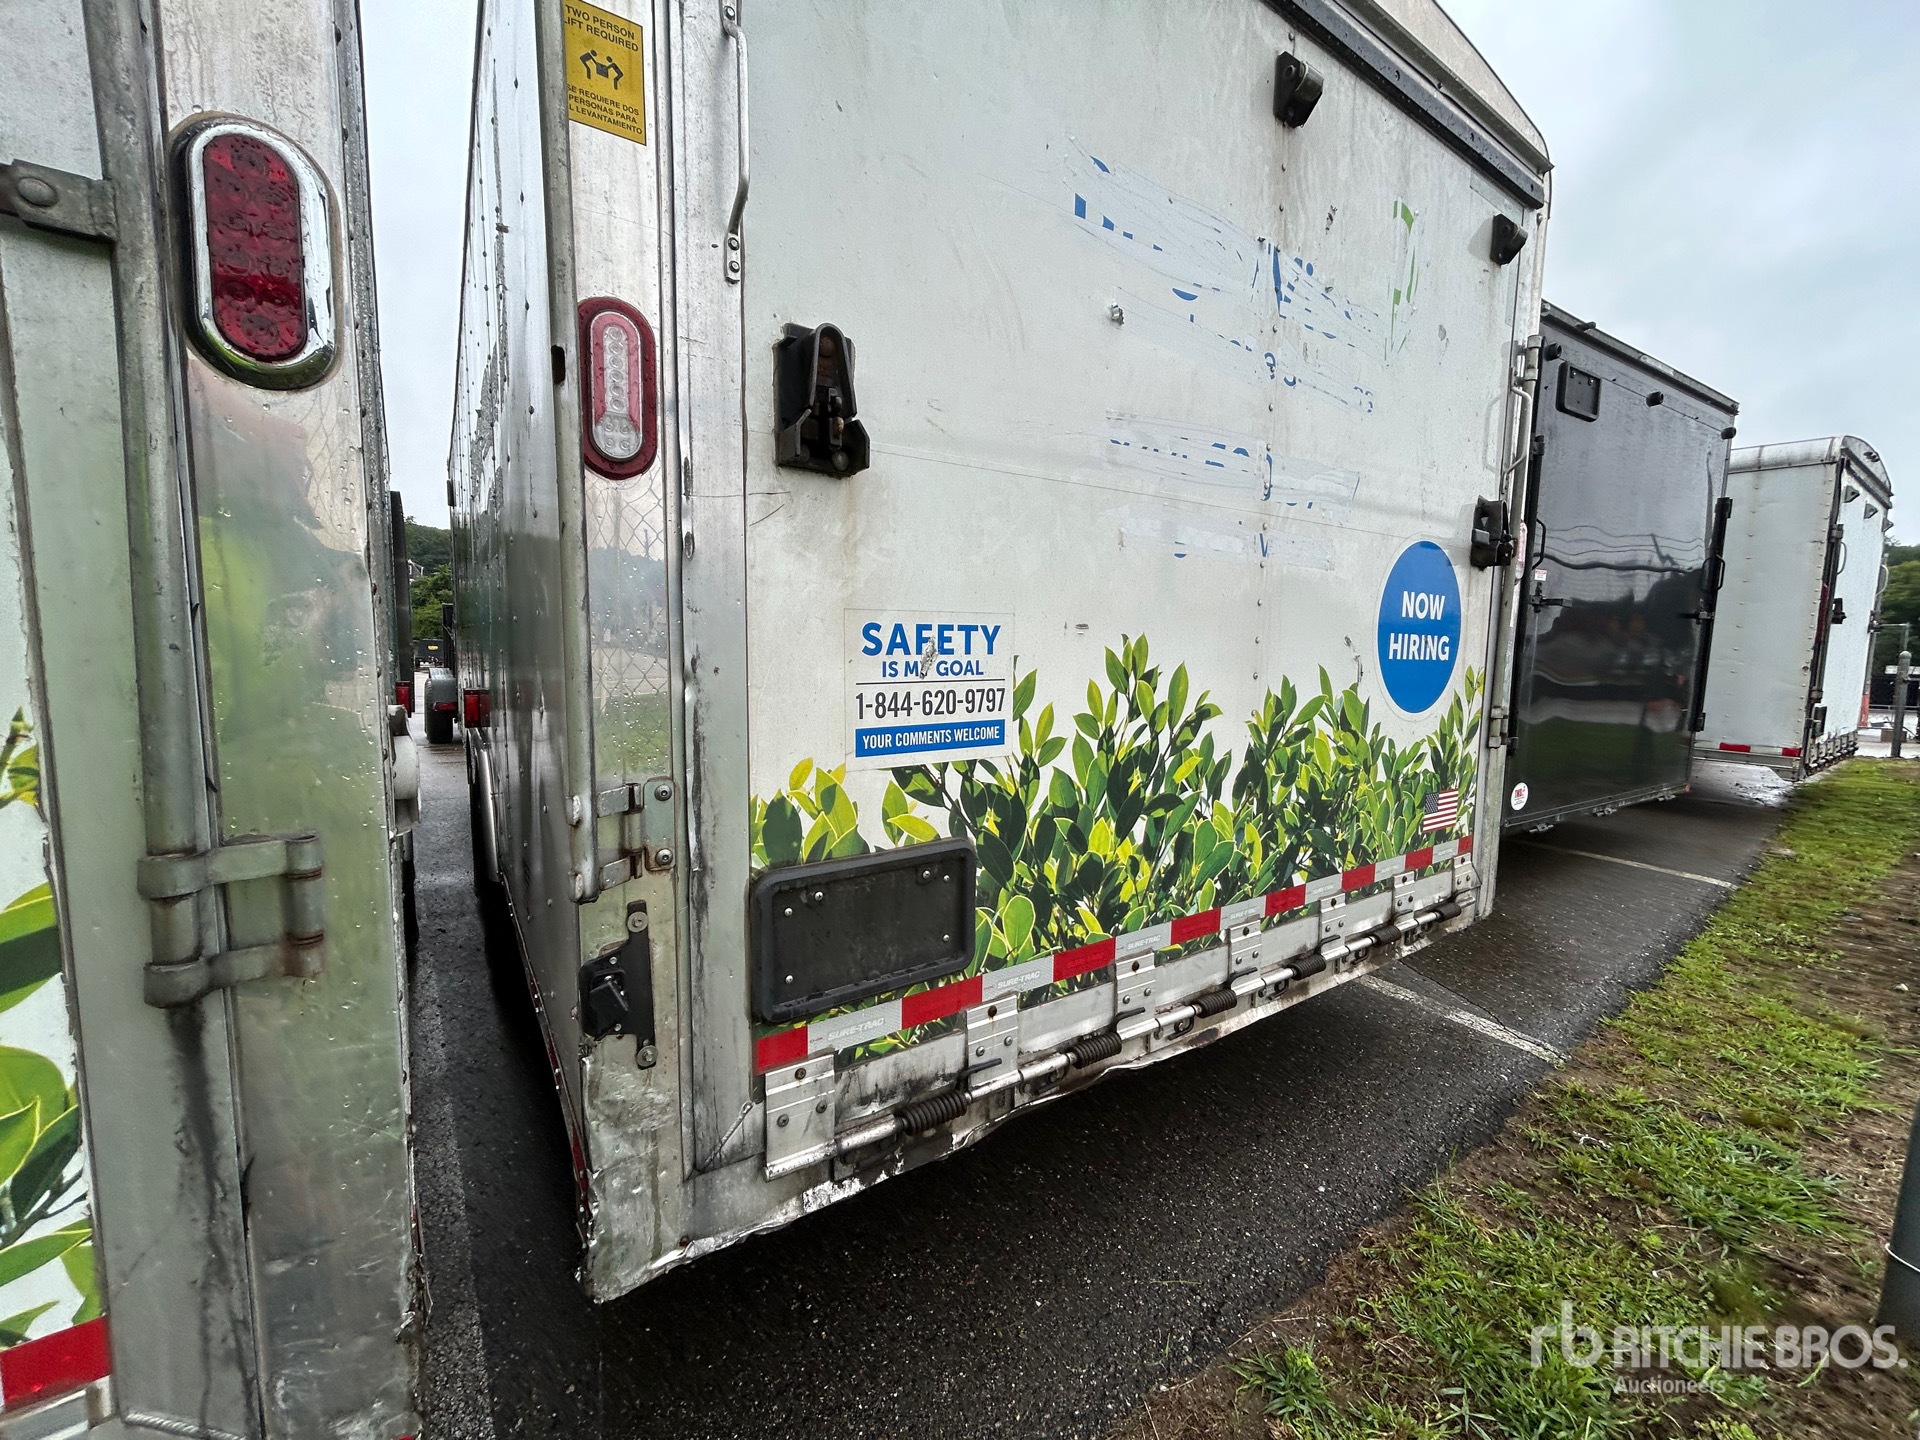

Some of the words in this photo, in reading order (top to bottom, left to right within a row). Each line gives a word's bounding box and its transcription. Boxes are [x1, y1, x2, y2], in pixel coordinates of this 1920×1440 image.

[564, 16, 584, 29] IFT
[586, 24, 639, 52] REQUIRED
[565, 4, 590, 21] TWO
[593, 15, 634, 40] PERSON
[567, 83, 577, 93] SE
[579, 88, 620, 109] REQUIERE
[622, 104, 639, 116] DOS
[568, 94, 614, 116] PERSONAS
[615, 110, 637, 124] PARA
[576, 105, 643, 135] LEVANTAMIENTO
[1401, 590, 1446, 621] NOW
[861, 621, 1002, 657] SAFETY
[1388, 632, 1450, 661] HIRING
[882, 661, 899, 678] IS
[904, 661, 928, 677] M
[936, 659, 984, 677] GOAL
[855, 687, 1006, 720] 1-844-620-9797
[862, 733, 893, 750] YOUR
[895, 729, 952, 747] COMMENTS
[954, 725, 1000, 743] WELCOME
